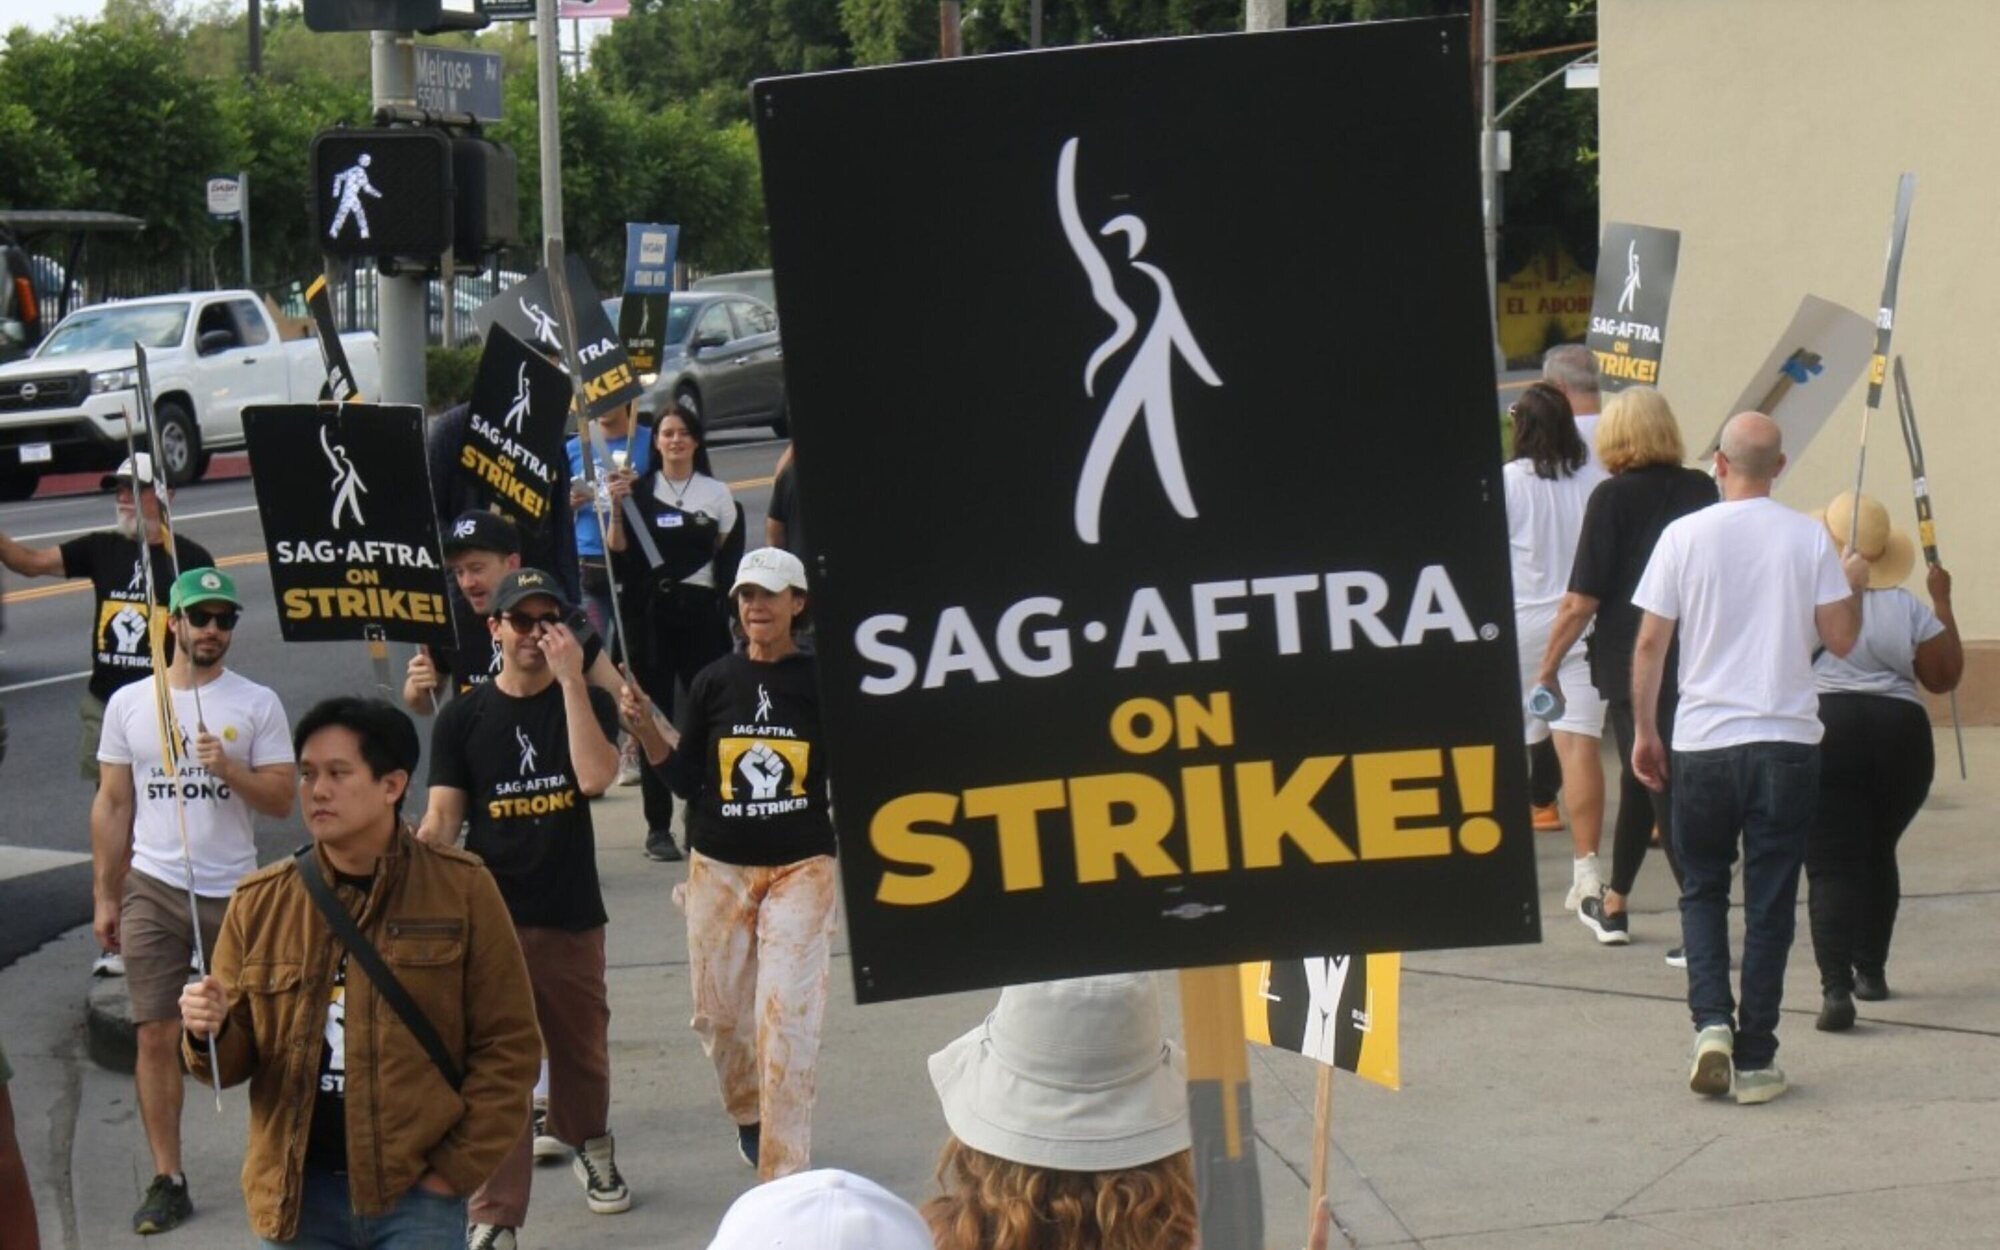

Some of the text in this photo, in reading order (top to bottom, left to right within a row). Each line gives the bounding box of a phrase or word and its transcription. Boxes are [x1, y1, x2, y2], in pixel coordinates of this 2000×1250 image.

[417, 49, 471, 90] Melrose
[1614, 341, 1629, 354] ON
[1593, 351, 1657, 382] TRIKE!
[498, 454, 515, 472] ON
[460, 445, 544, 517] STRIKE!
[346, 569, 379, 585] ON
[283, 588, 446, 624] STRIKE!
[113, 653, 153, 668] STRIK
[1110, 692, 1234, 753] ON
[147, 783, 230, 799] STRONG
[721, 798, 808, 817] ON STRIKE!
[869, 745, 1501, 906] STRIKE!
